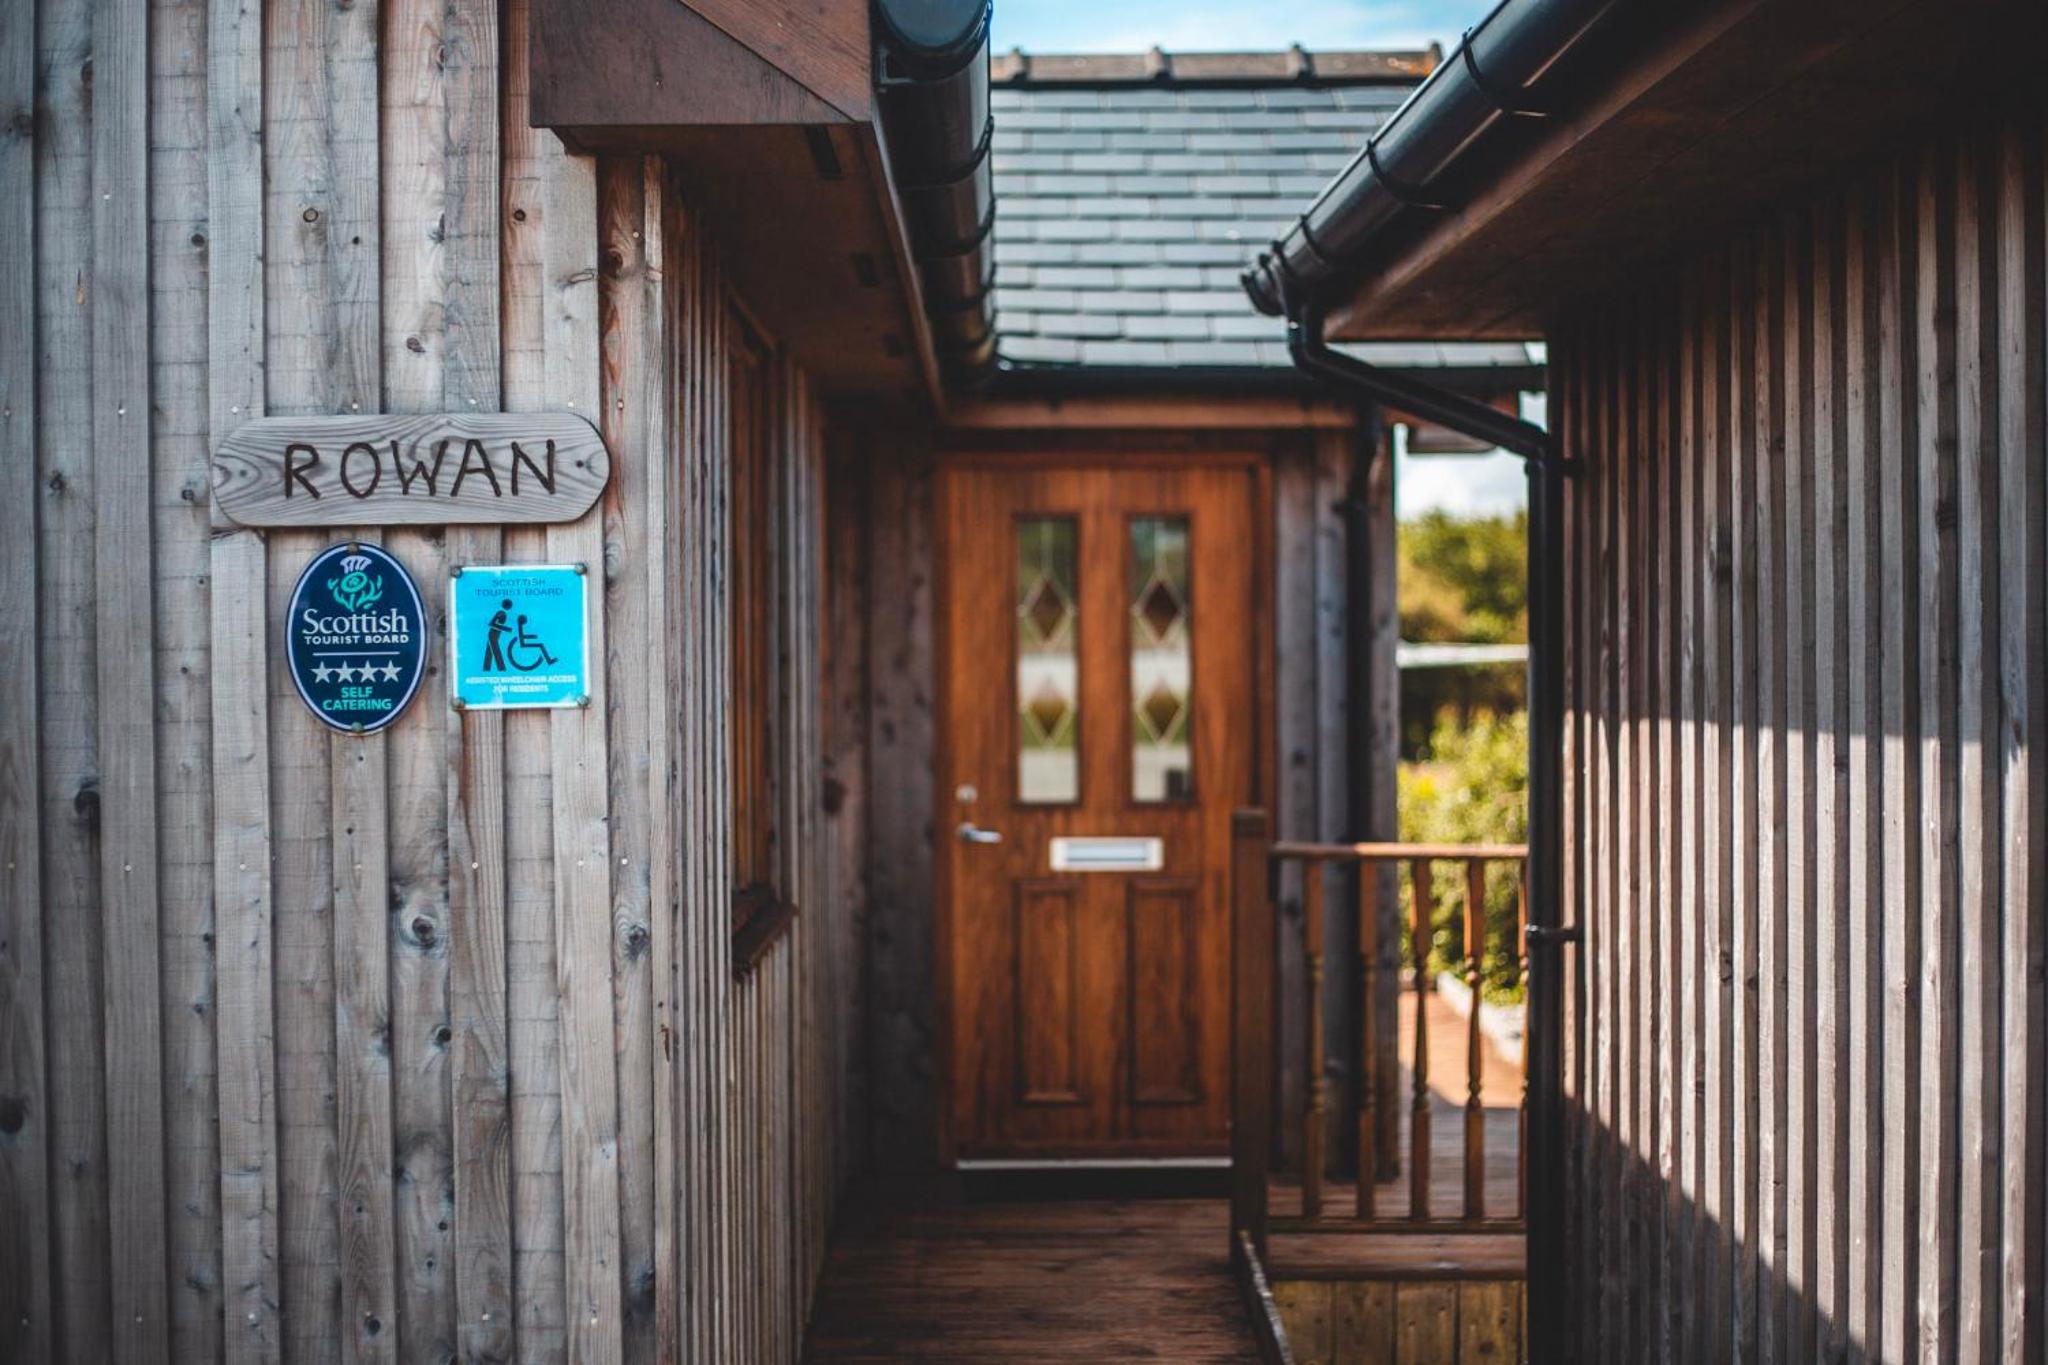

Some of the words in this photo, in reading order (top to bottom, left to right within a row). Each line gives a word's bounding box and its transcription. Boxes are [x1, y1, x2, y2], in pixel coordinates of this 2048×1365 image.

[284, 438, 556, 500] ROWAN
[491, 578, 546, 587] SCOTTISH
[475, 588, 521, 597] TOURIST
[525, 587, 564, 596] BOARD
[302, 608, 410, 635] Scottish
[304, 635, 361, 646] TOURIST
[365, 634, 410, 644] BOARD
[548, 674, 577, 683] ACCESS
[341, 686, 373, 699] SELF
[322, 698, 393, 711] CATERING
